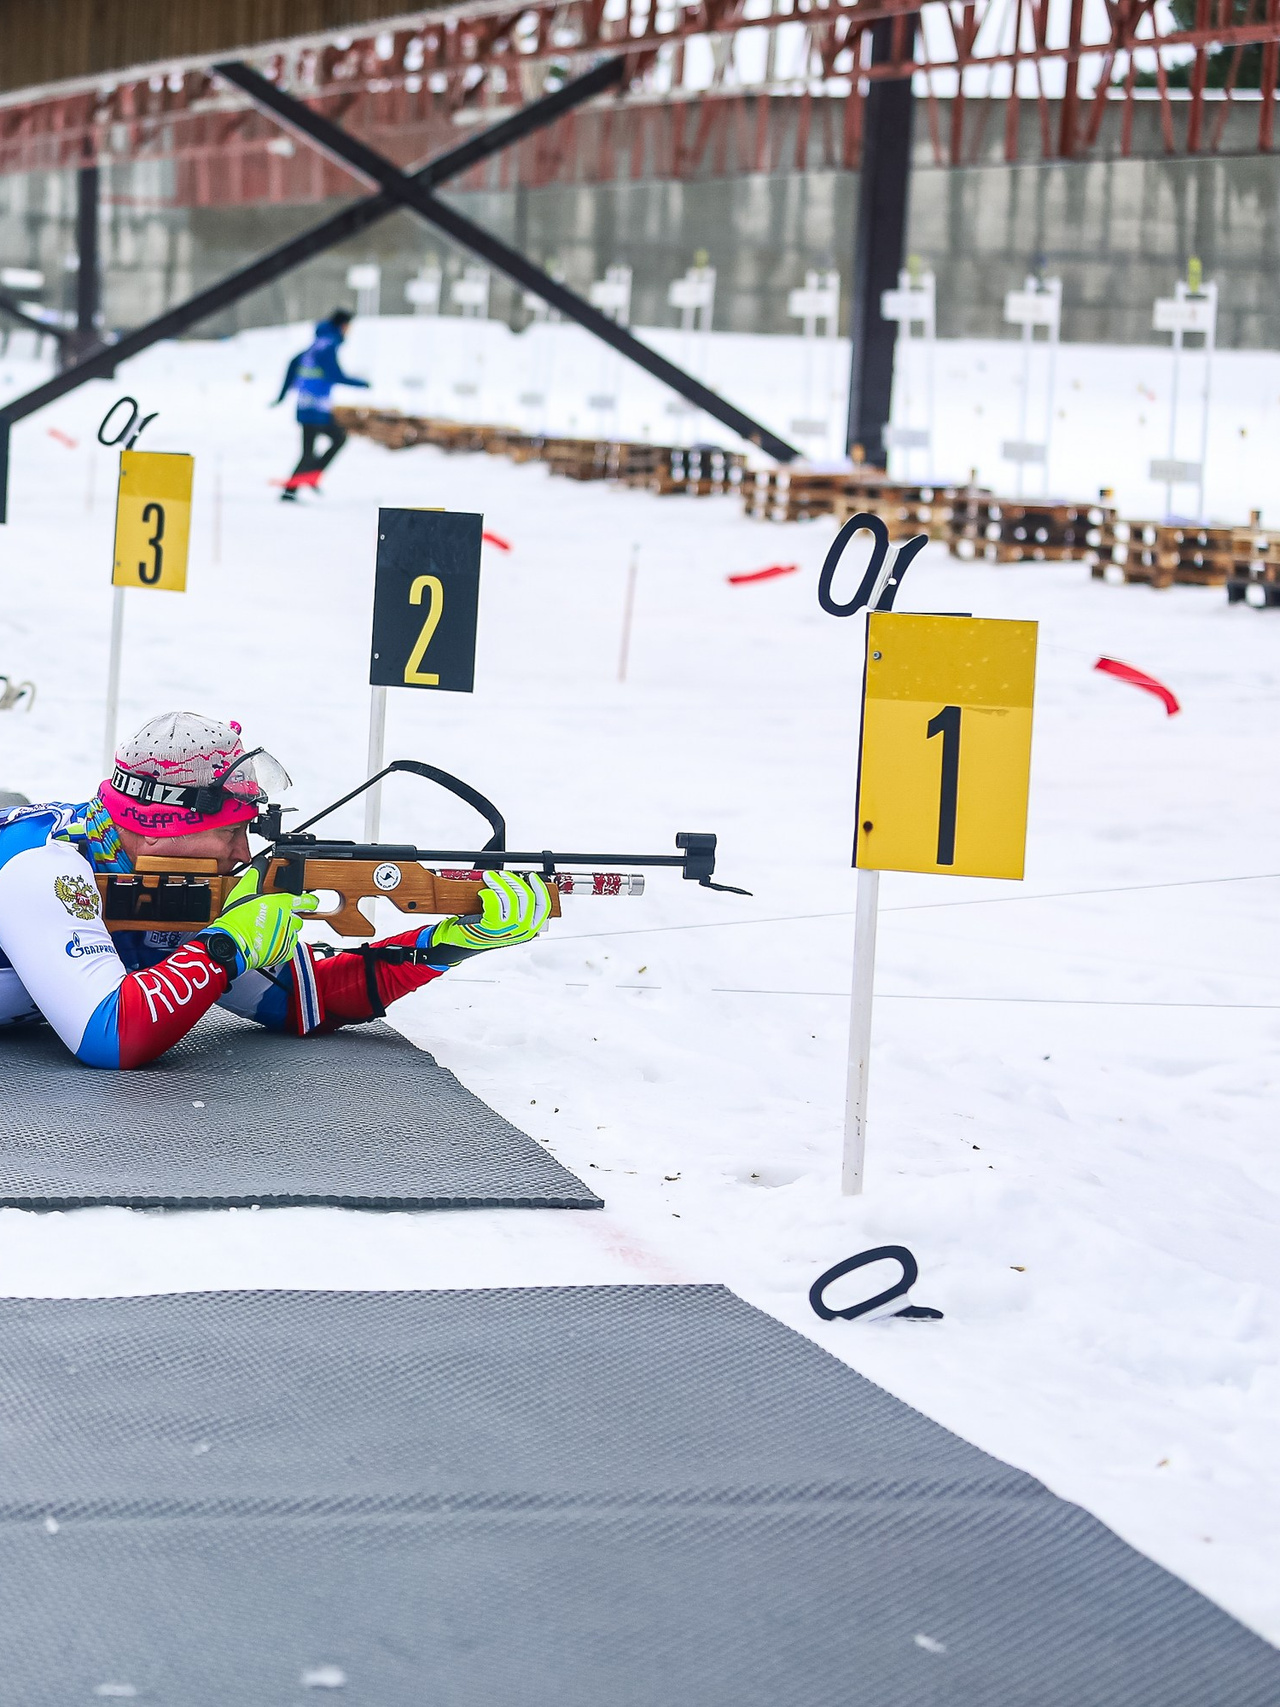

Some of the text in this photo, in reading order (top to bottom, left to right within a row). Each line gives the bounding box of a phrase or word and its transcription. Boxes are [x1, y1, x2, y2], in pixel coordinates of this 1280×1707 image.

[138, 502, 166, 585] 3
[404, 574, 444, 685] 2
[926, 705, 962, 865] 1
